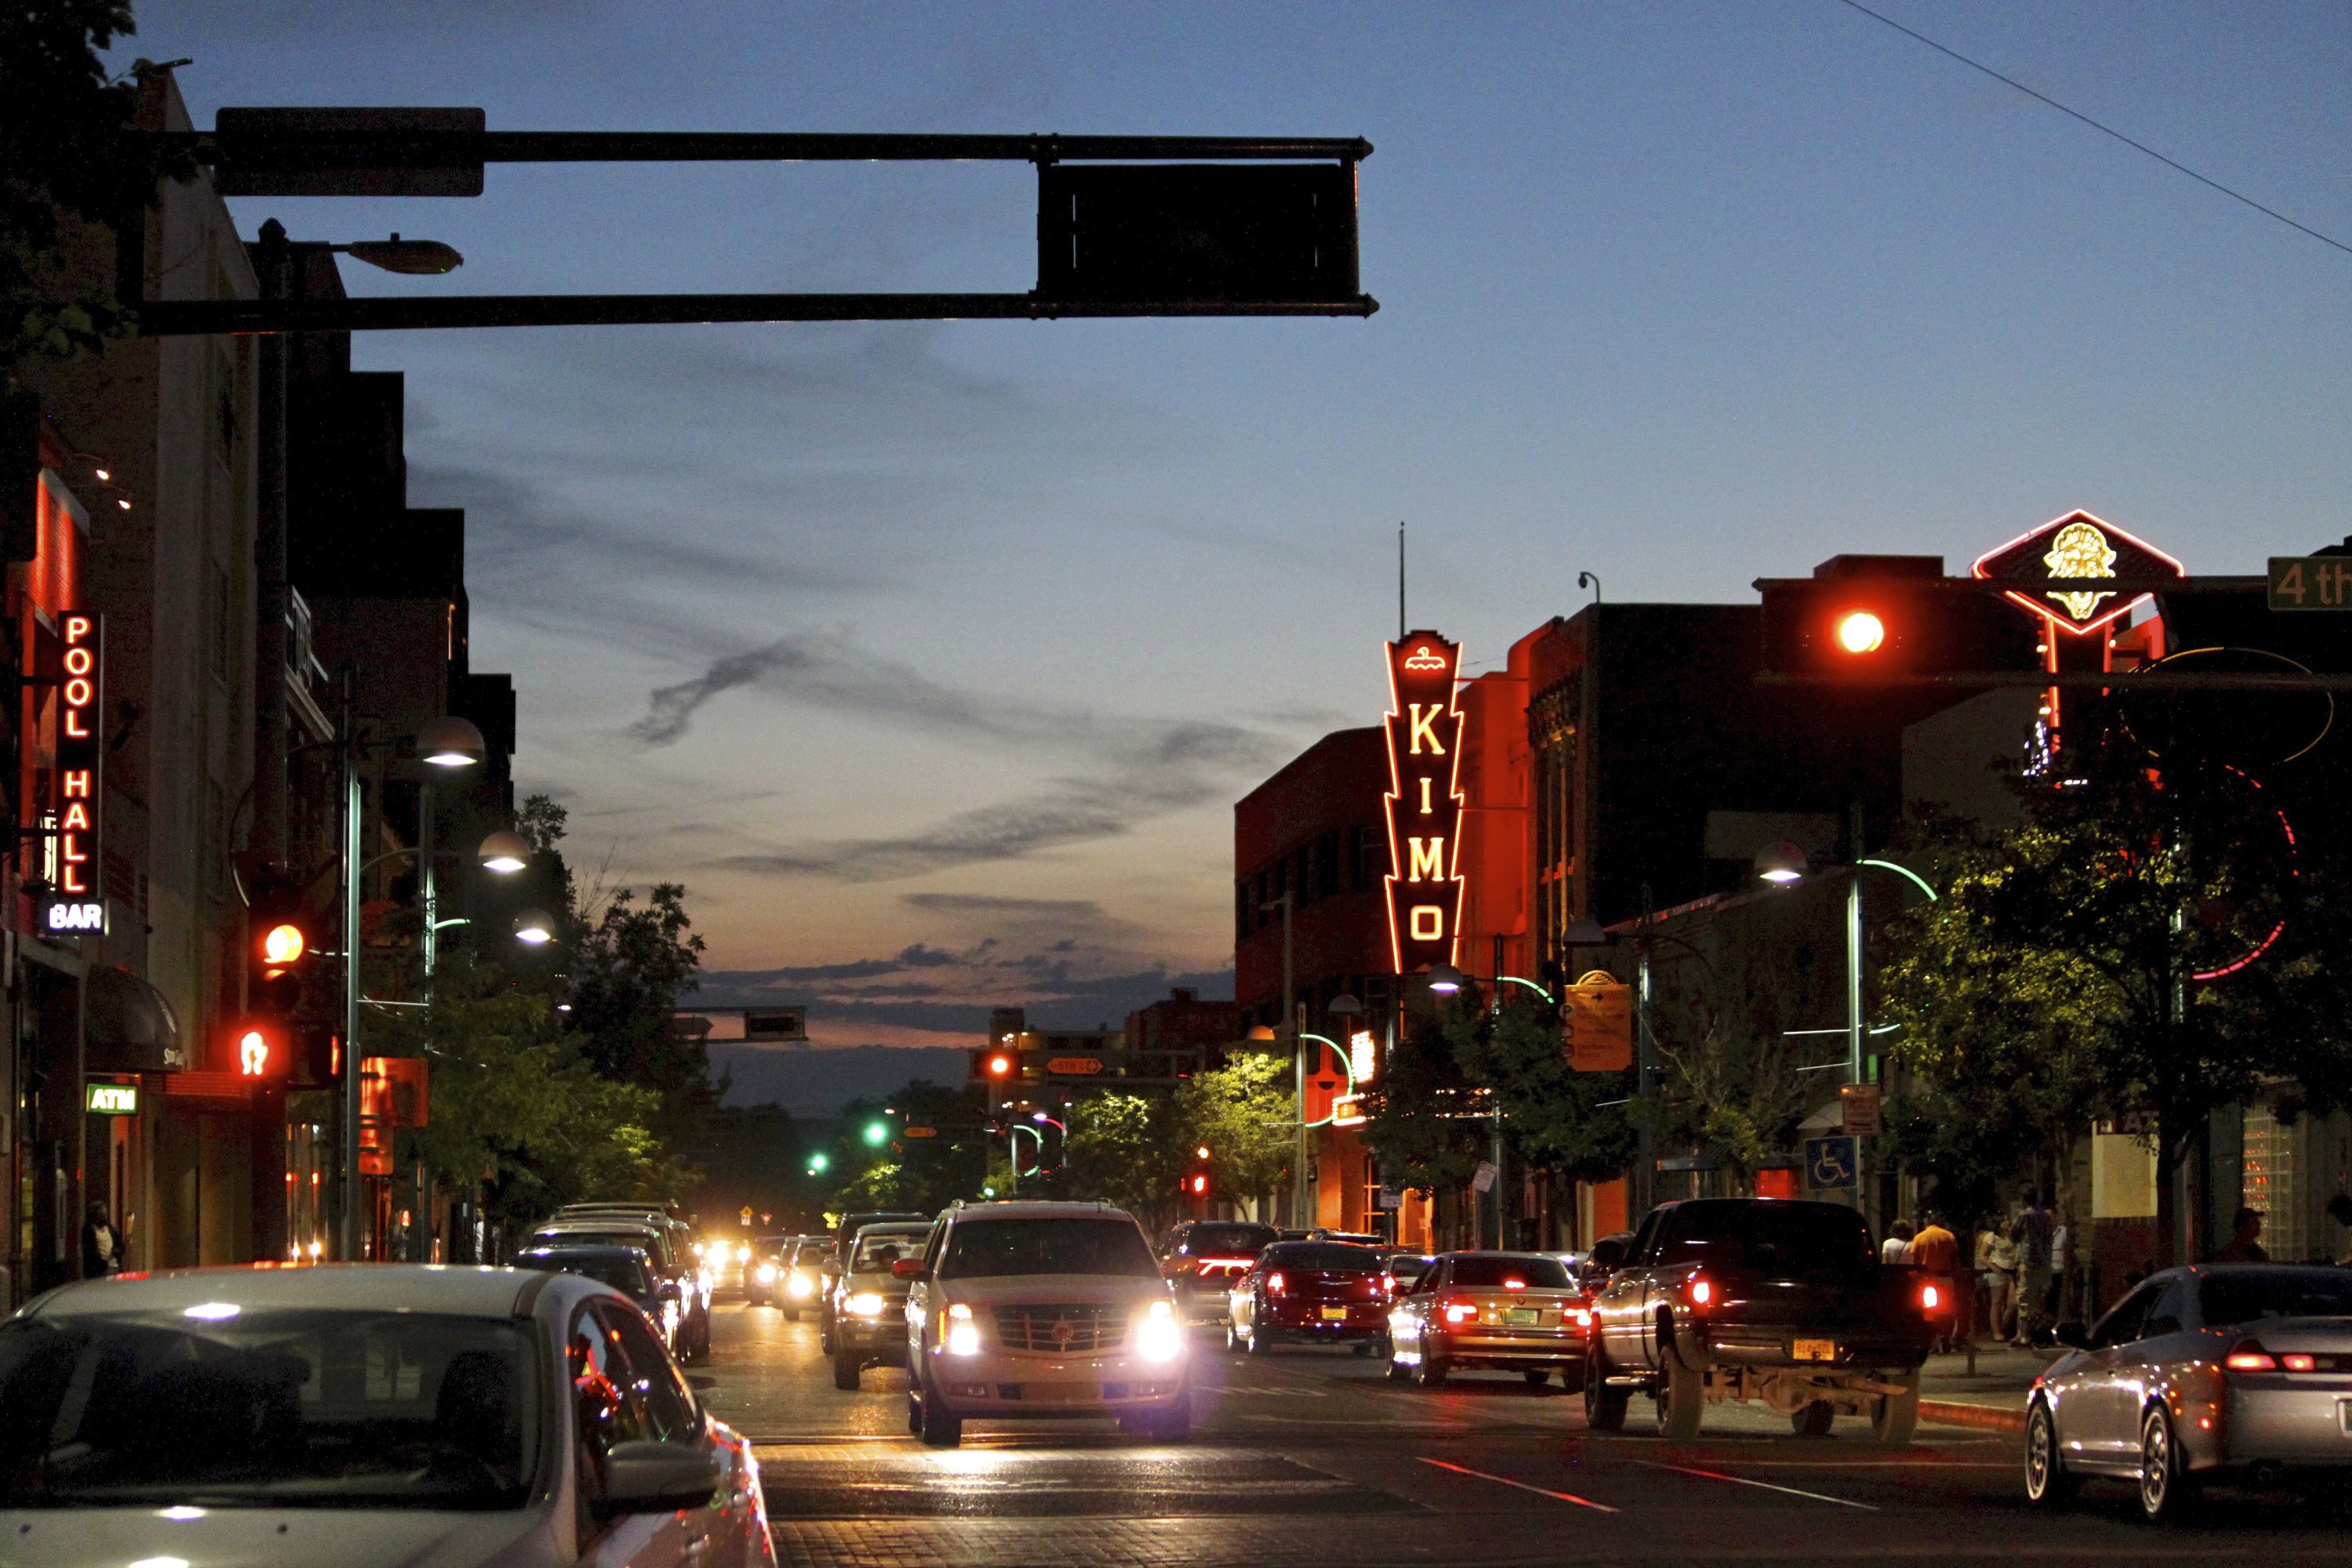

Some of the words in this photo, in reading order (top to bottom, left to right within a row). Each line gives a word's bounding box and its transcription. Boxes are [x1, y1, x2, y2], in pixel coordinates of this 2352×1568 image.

[64, 616, 93, 738] POOL
[64, 770, 89, 893] HALL
[1409, 703, 1445, 942] KIMO
[49, 904, 101, 928] BAR
[90, 1088, 135, 1110] ATM
